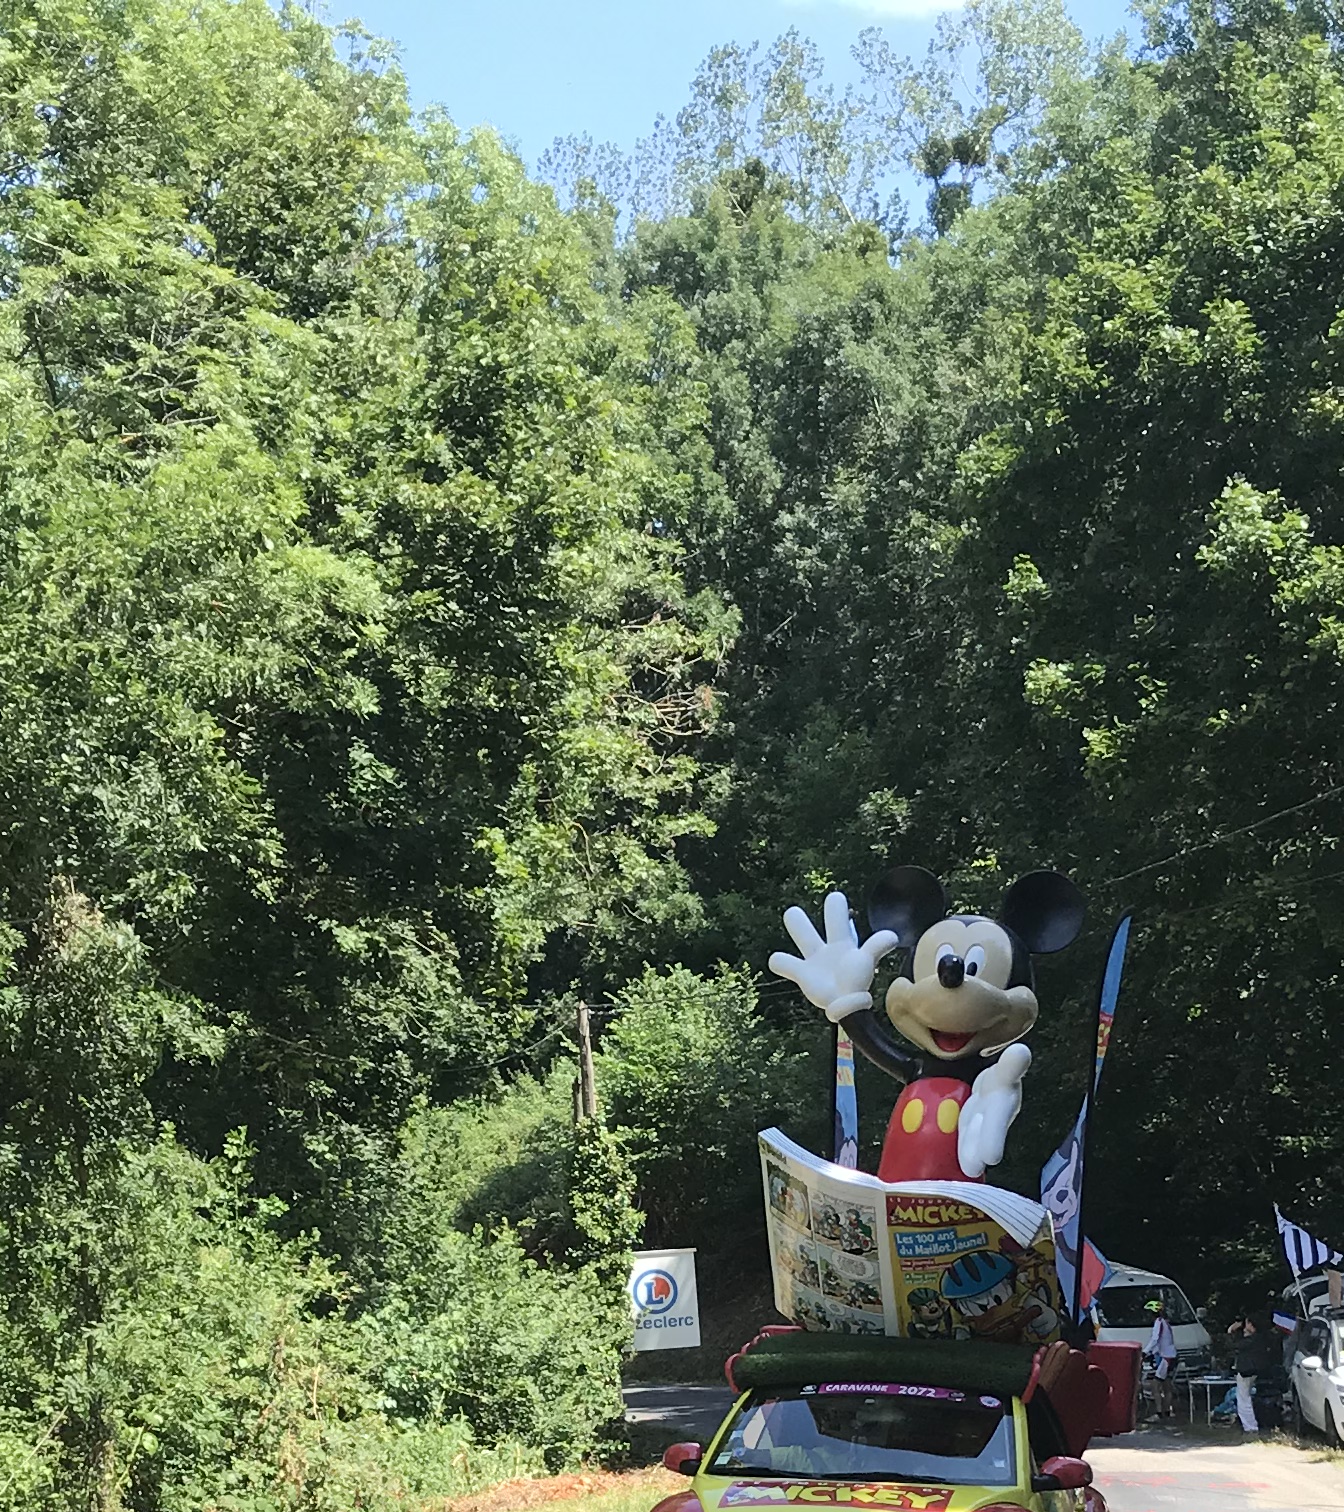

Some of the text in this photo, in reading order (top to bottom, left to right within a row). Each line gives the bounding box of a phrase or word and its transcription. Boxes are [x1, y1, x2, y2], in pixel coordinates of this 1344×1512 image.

[894, 1206, 985, 1224] MICKEY
[895, 1231, 955, 1244] Les 100 ans
[899, 1245, 913, 1255] du
[915, 1243, 952, 1255] Maillot
[635, 1315, 694, 1330] Leclerc
[825, 1384, 936, 1398] CARAVANE 2072
[736, 1484, 946, 1510] MICKEY
